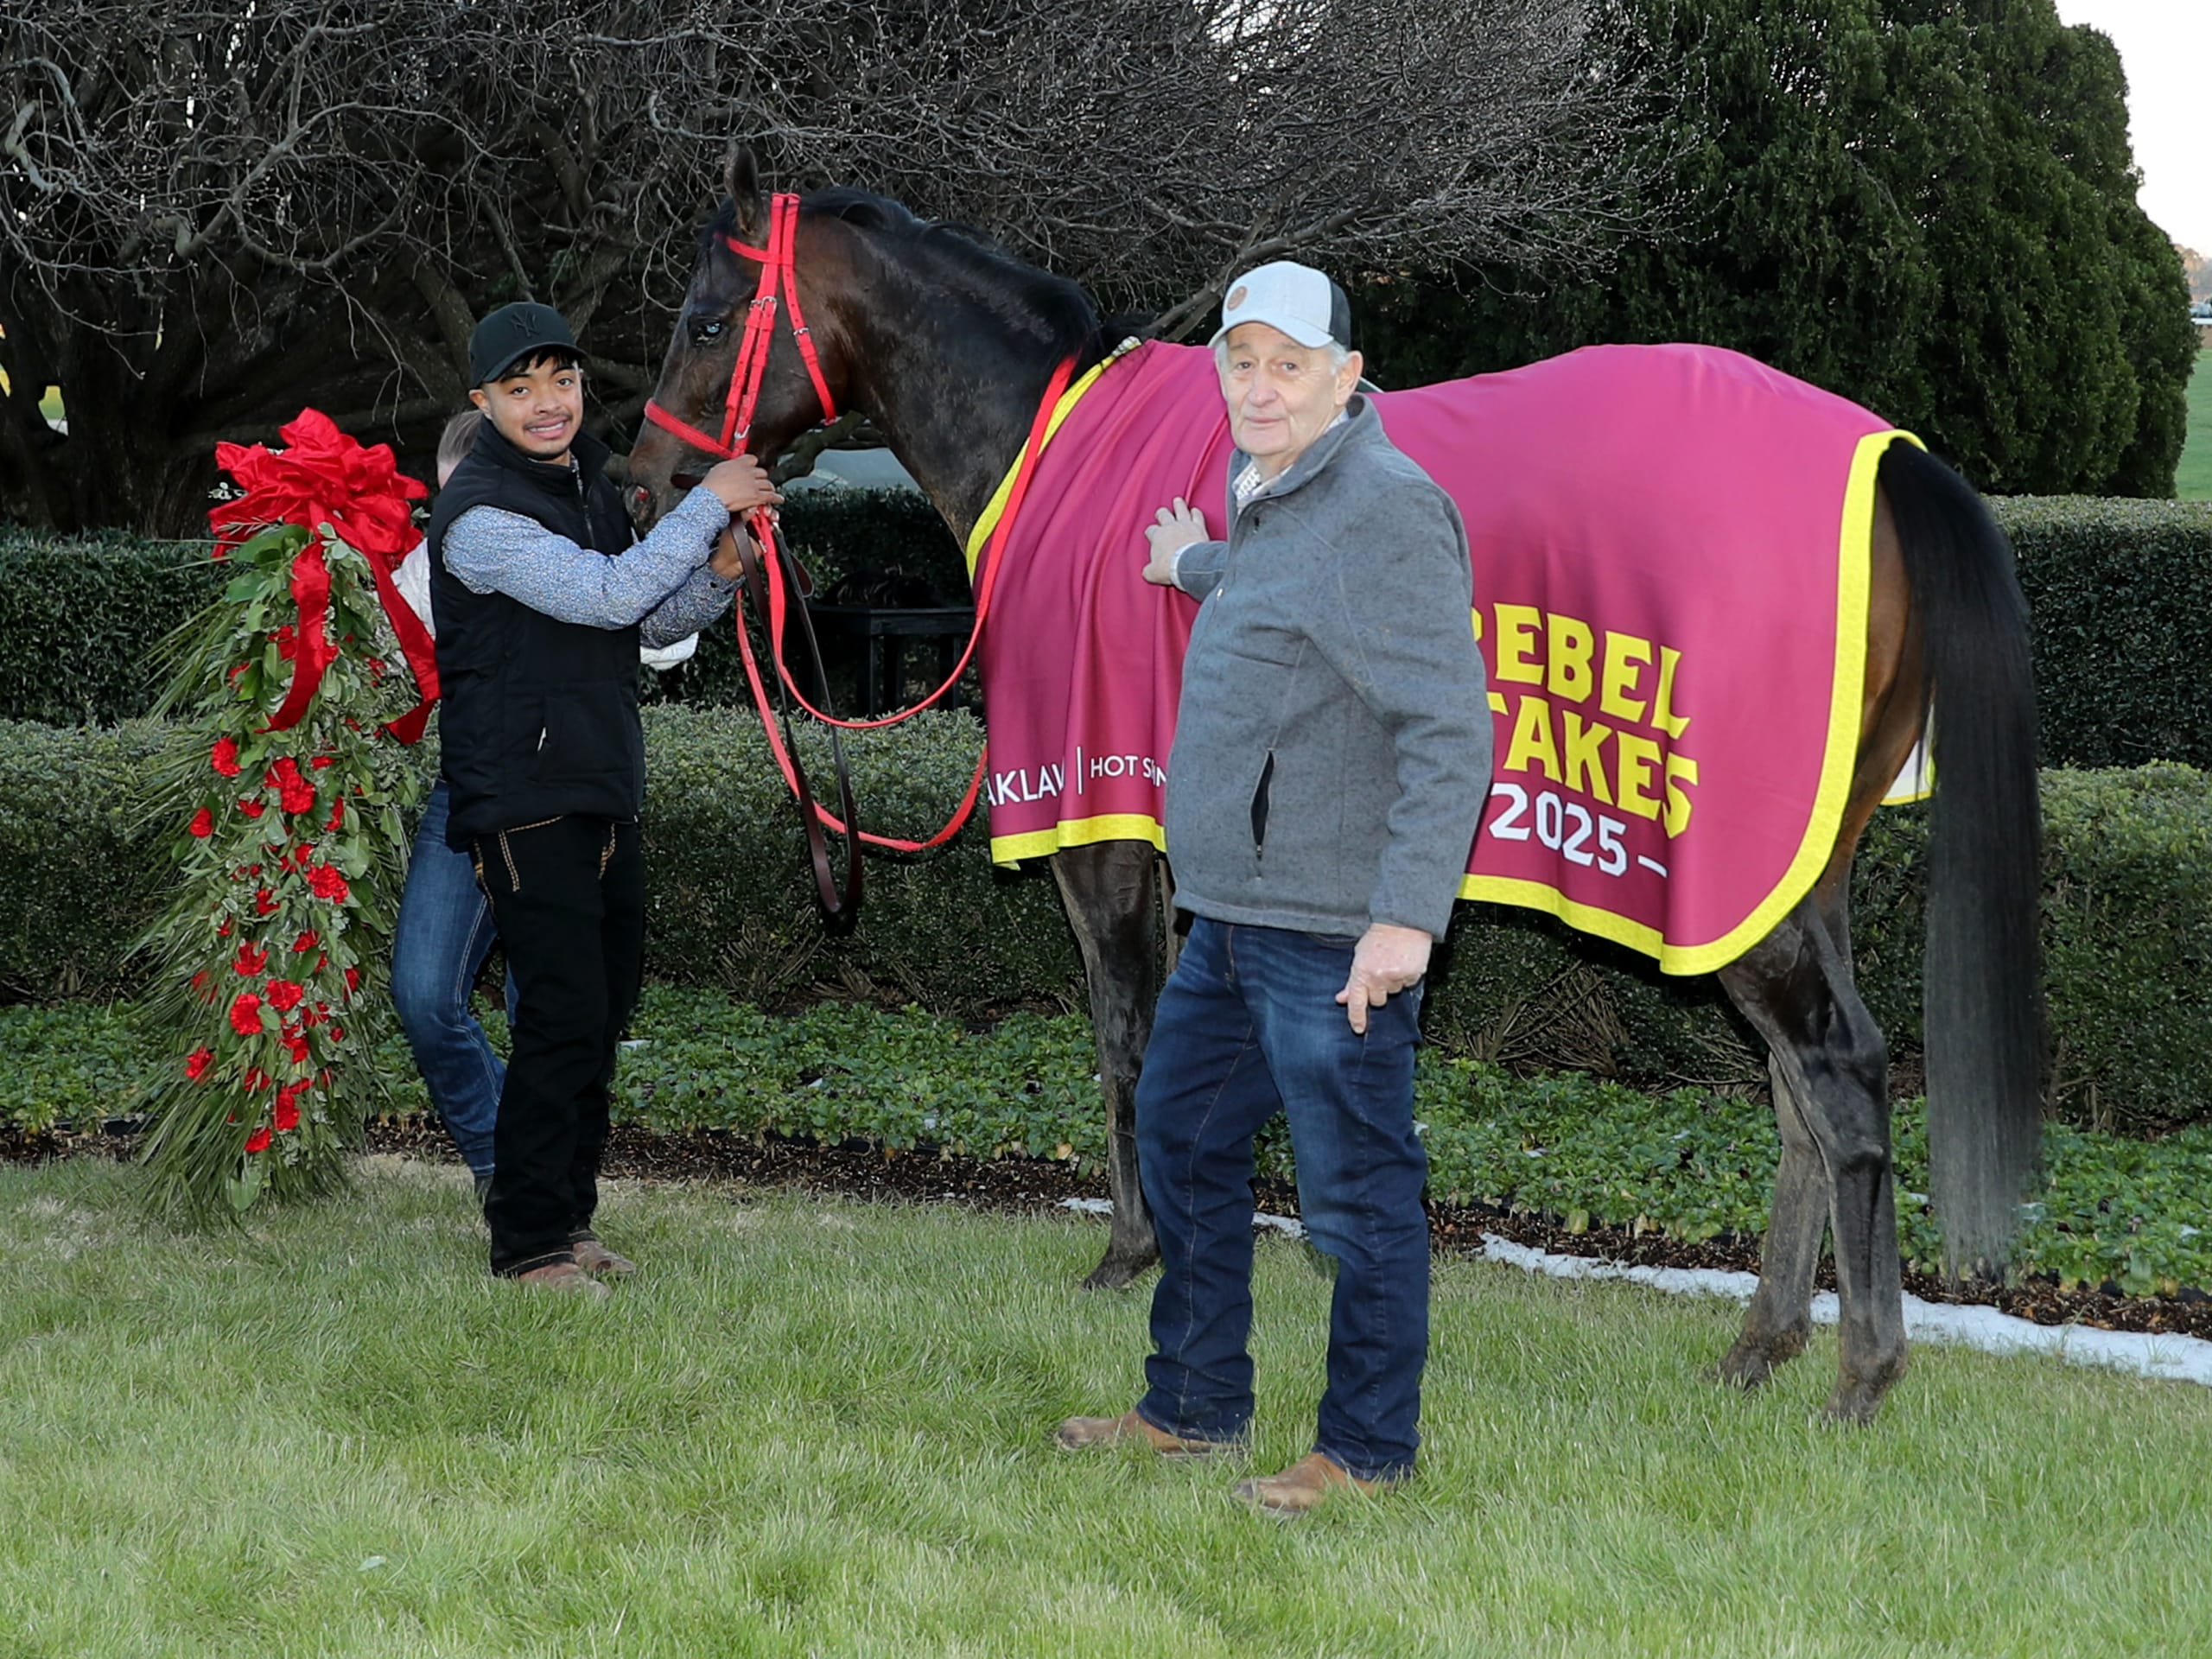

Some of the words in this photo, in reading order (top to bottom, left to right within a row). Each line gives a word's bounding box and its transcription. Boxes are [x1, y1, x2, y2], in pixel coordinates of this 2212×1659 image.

[1471, 602, 1691, 741] EBEL
[1090, 755, 1139, 778] HOT
[1488, 783, 1628, 877] 2025
